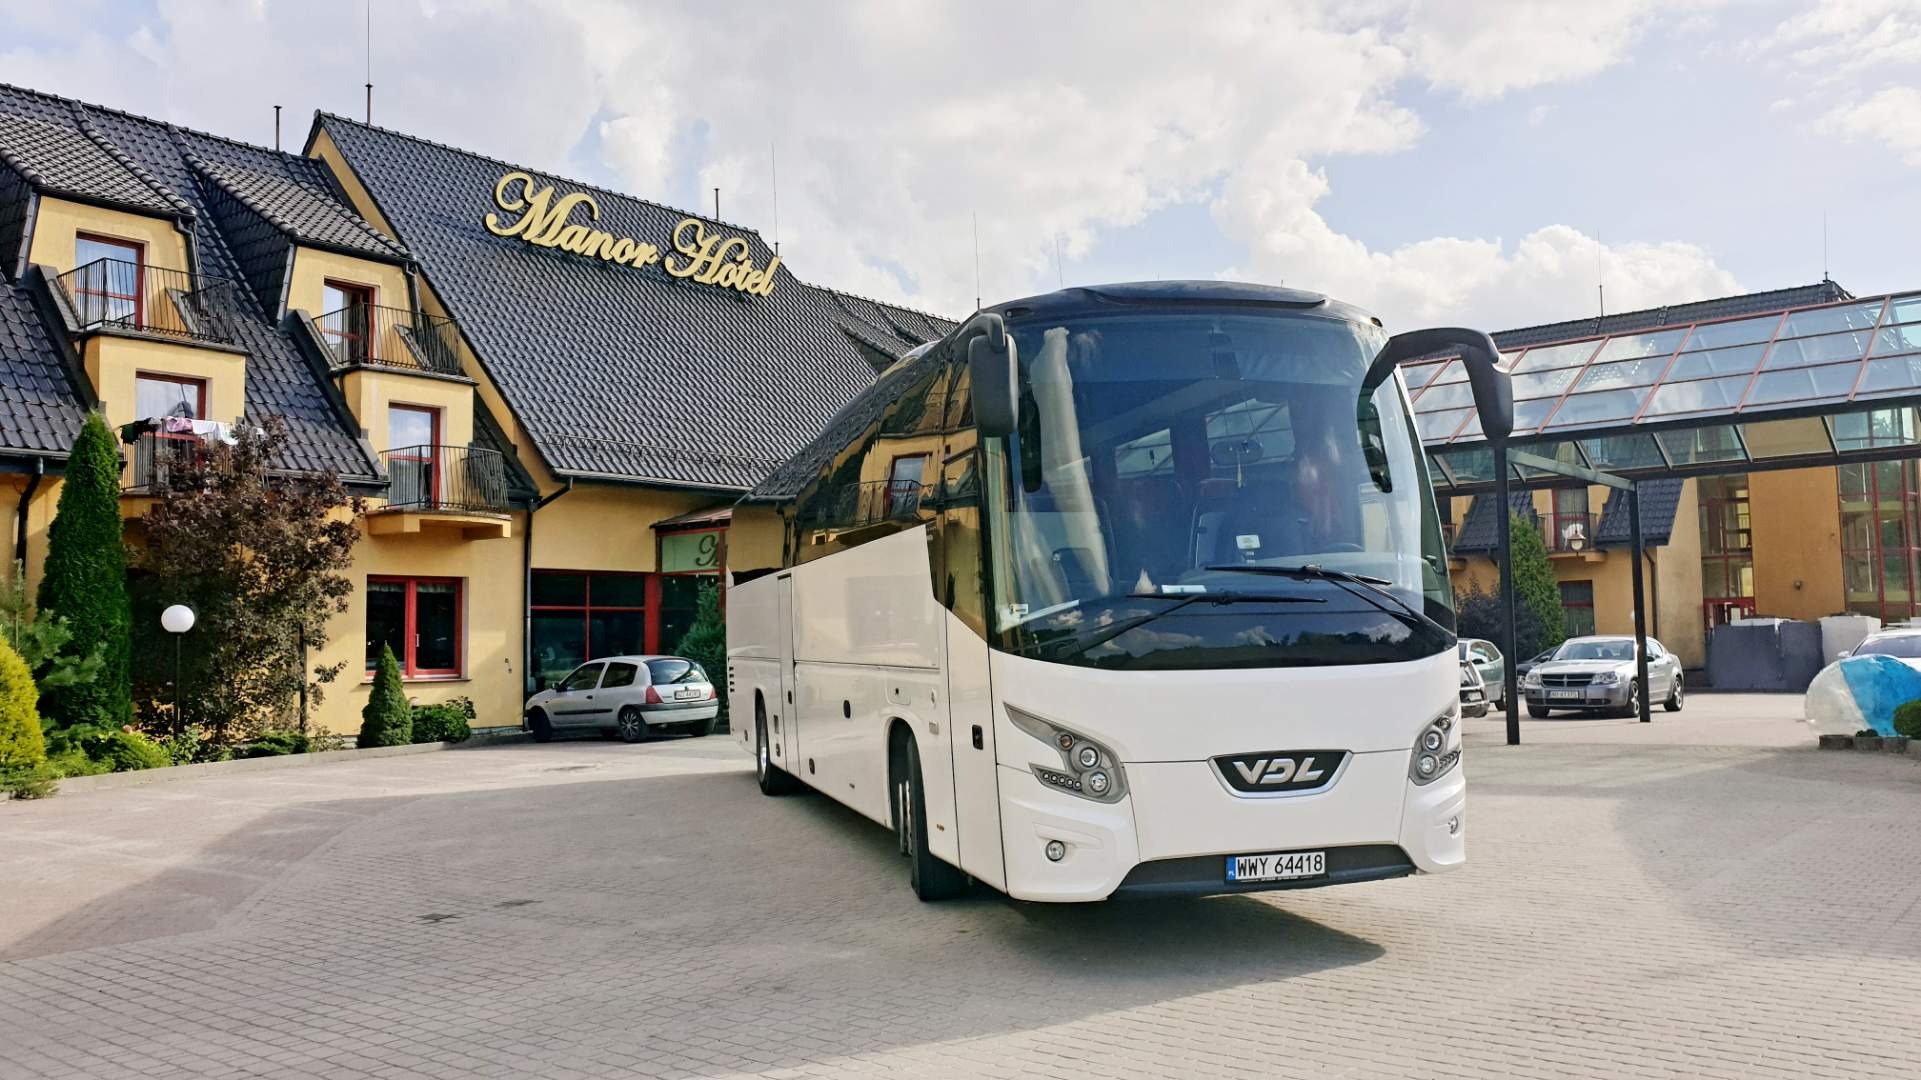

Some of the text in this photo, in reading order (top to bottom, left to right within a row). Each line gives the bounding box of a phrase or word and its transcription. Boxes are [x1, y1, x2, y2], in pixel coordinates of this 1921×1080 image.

[485, 171, 782, 297] Manor Hotel
[1232, 757, 1324, 785] VDL
[1237, 854, 1323, 877] WWY 64418
